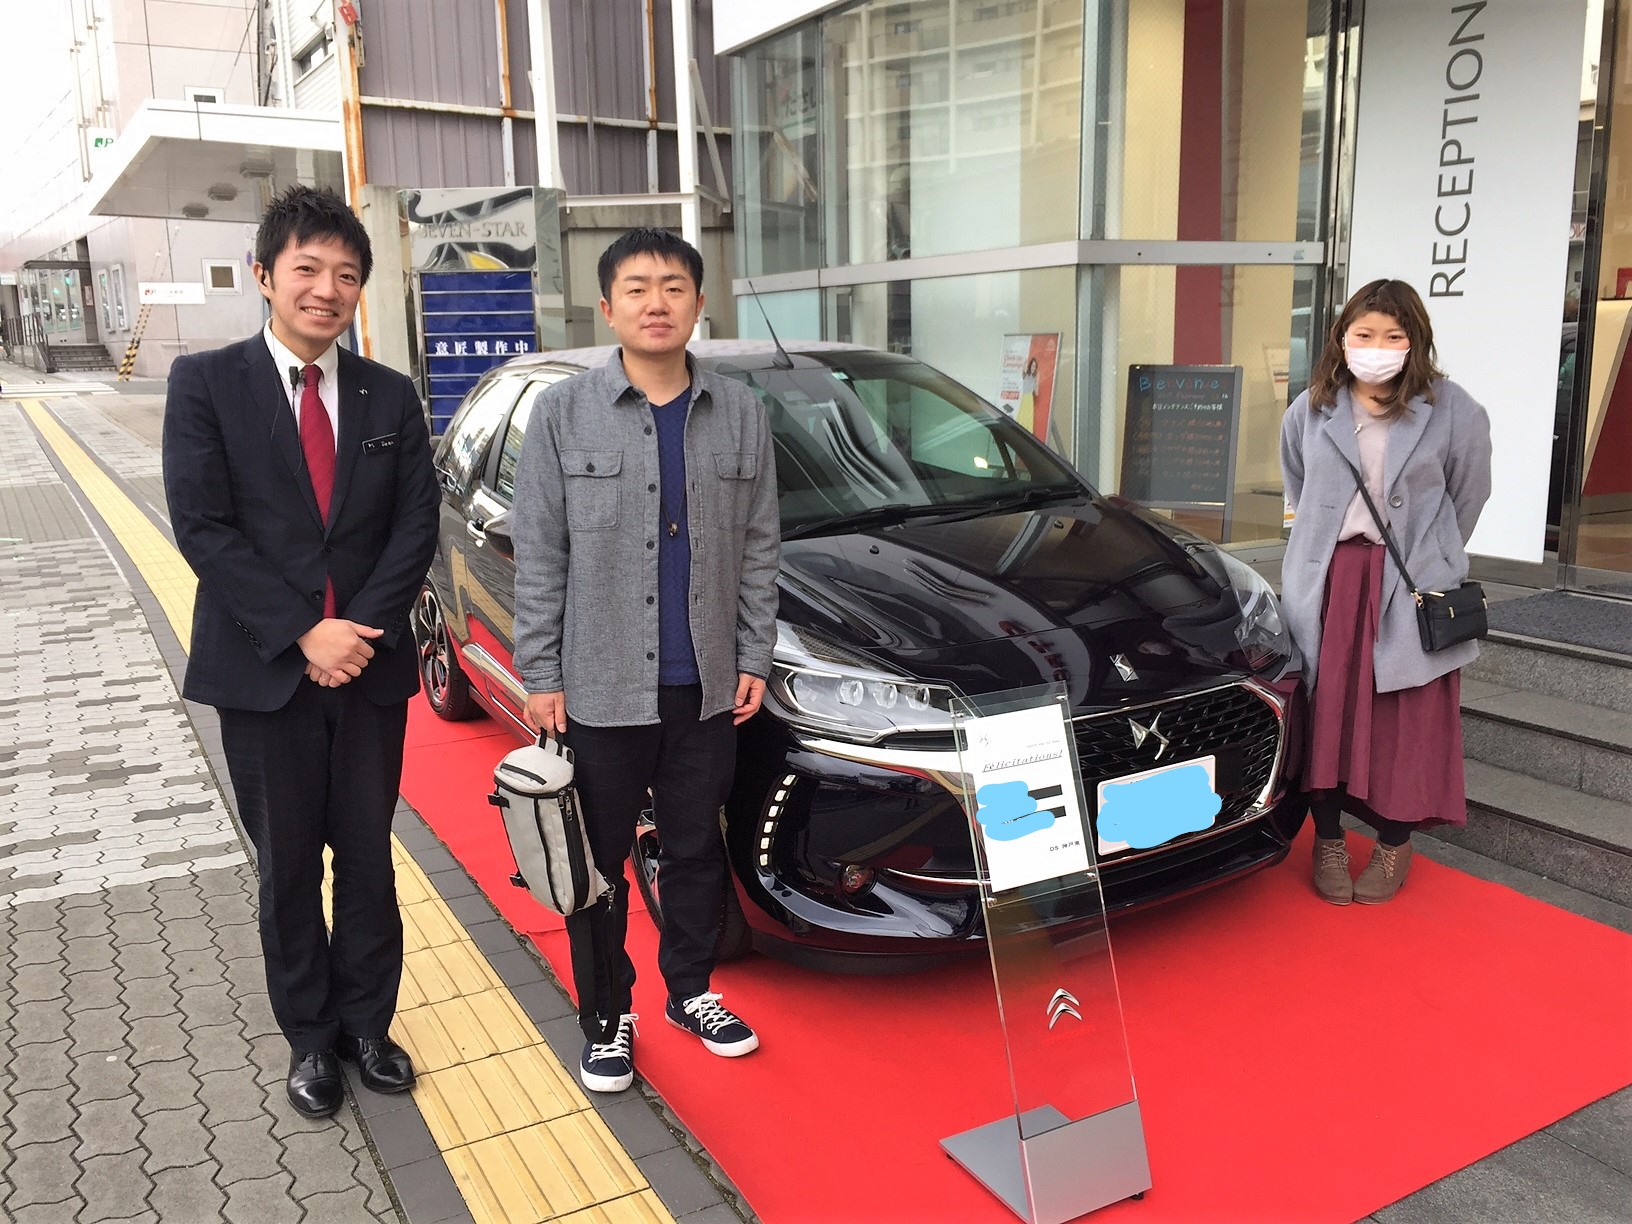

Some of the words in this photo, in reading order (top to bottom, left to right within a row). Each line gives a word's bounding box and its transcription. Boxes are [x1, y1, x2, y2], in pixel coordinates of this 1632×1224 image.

[1429, 0, 1488, 298] RECEPTION
[435, 339, 529, 355] 意匠製作中
